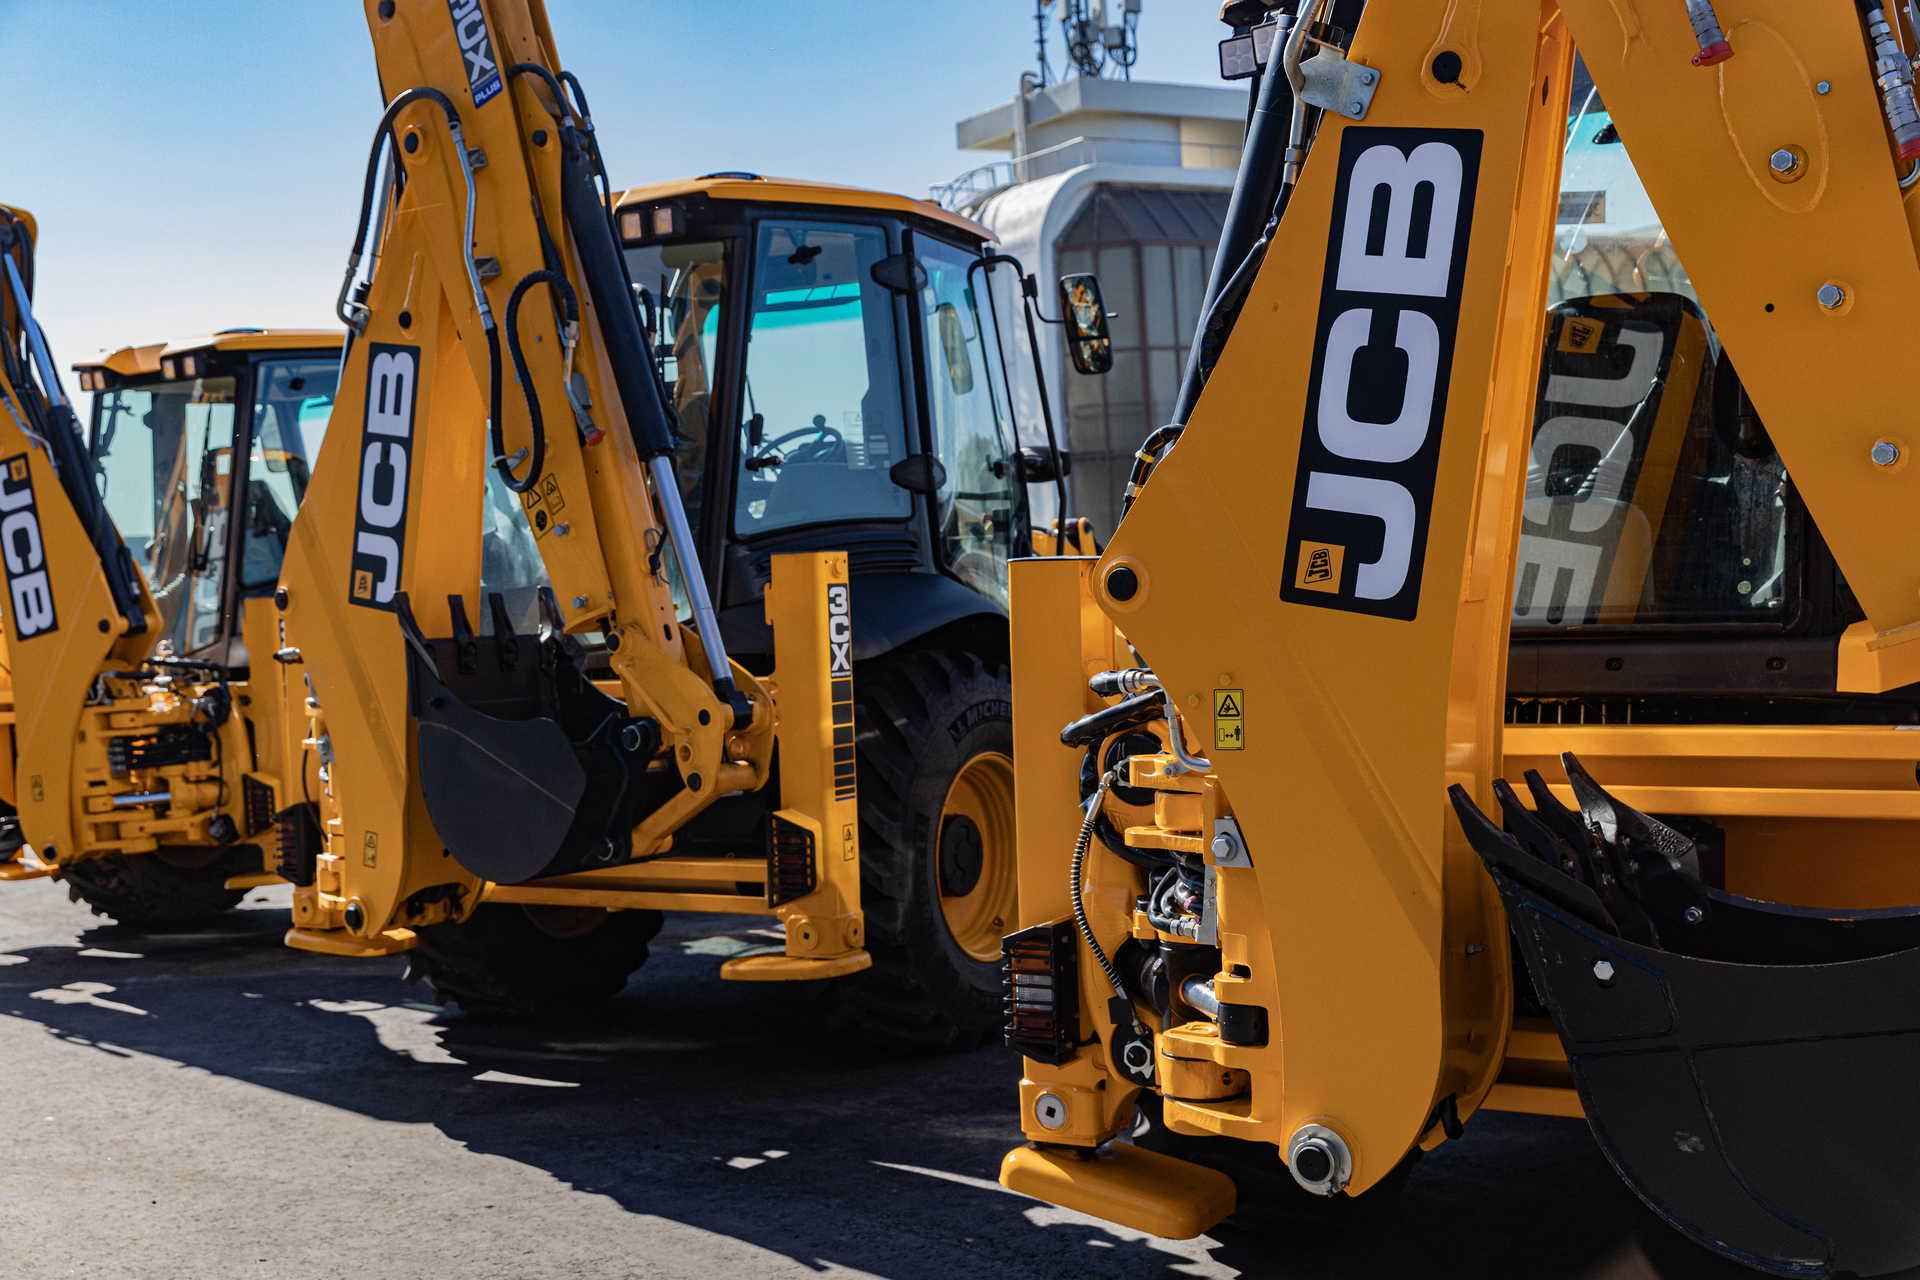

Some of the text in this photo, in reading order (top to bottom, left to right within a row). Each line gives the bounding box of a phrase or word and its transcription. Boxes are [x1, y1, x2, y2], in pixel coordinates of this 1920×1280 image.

[474, 79, 500, 104] PLUS
[1306, 142, 1463, 600] JCB
[357, 352, 415, 603] JCB
[0, 463, 54, 636] JCB
[1307, 551, 1330, 578] JCB
[829, 586, 851, 671] 3CX
[965, 700, 1009, 728] MICHE
